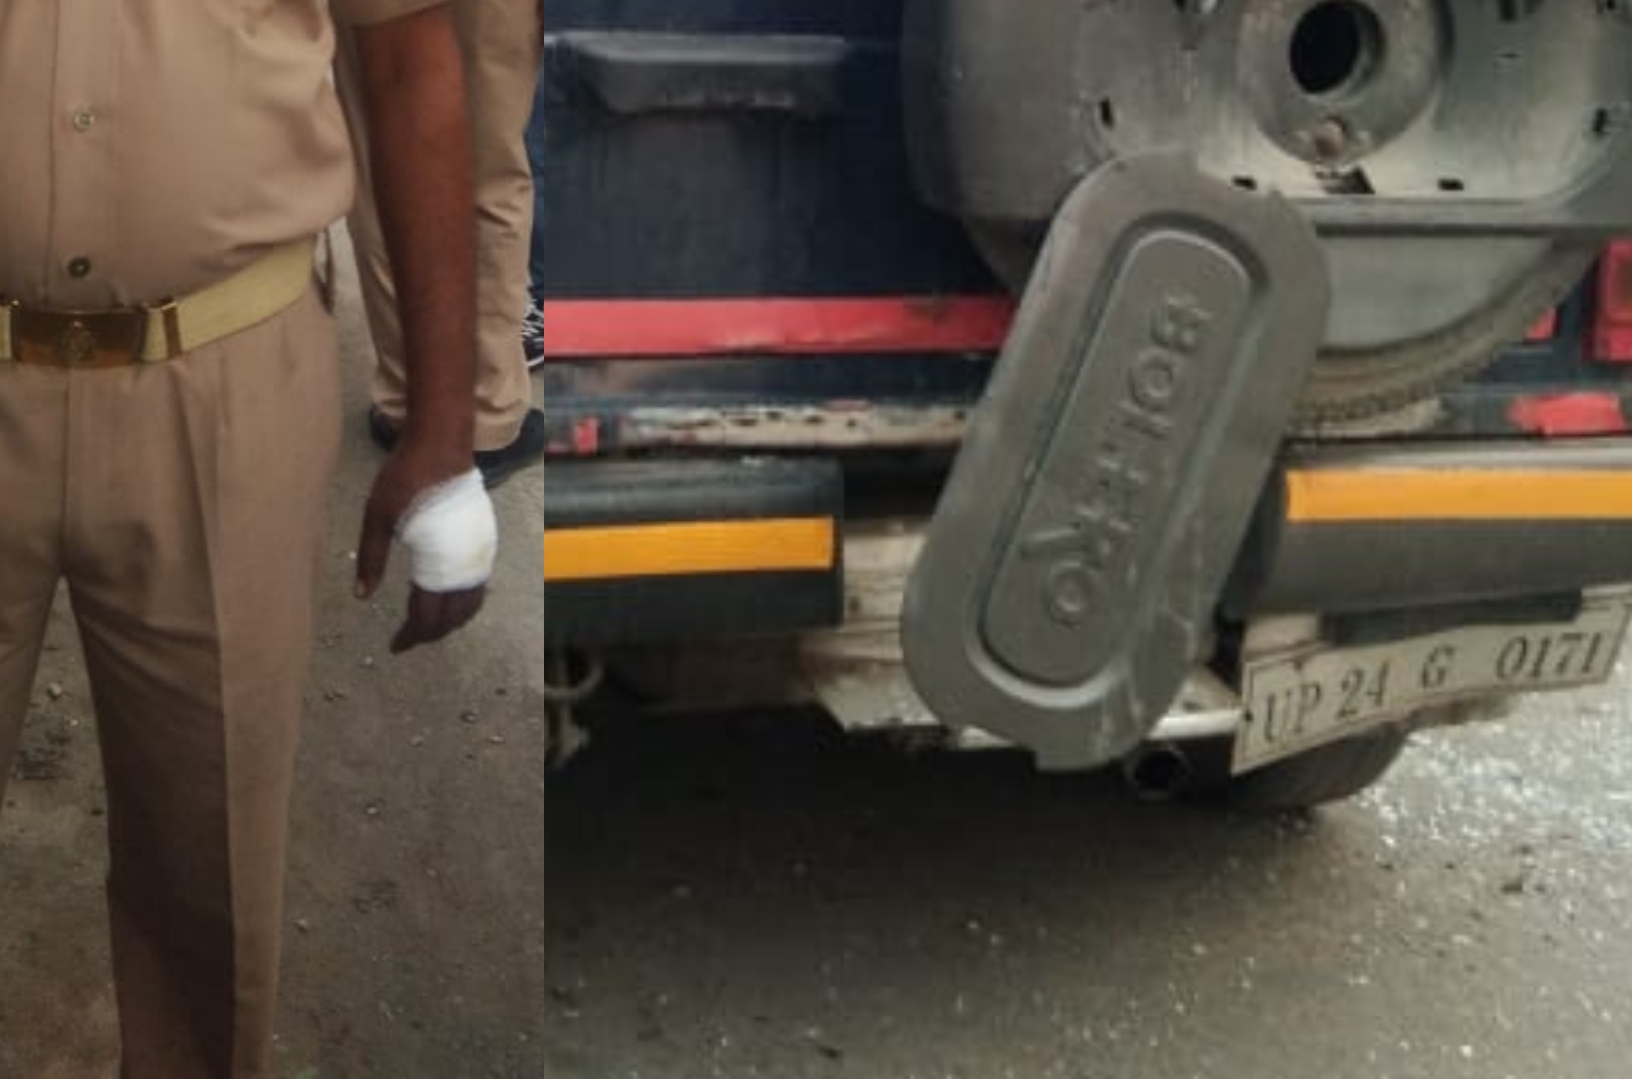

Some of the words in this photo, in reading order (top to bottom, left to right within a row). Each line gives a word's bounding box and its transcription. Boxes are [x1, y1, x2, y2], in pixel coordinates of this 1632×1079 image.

[1262, 681, 1322, 745] UP
[1337, 661, 1391, 720] 24
[1420, 643, 1456, 689] G
[1495, 631, 1603, 682] 0171
